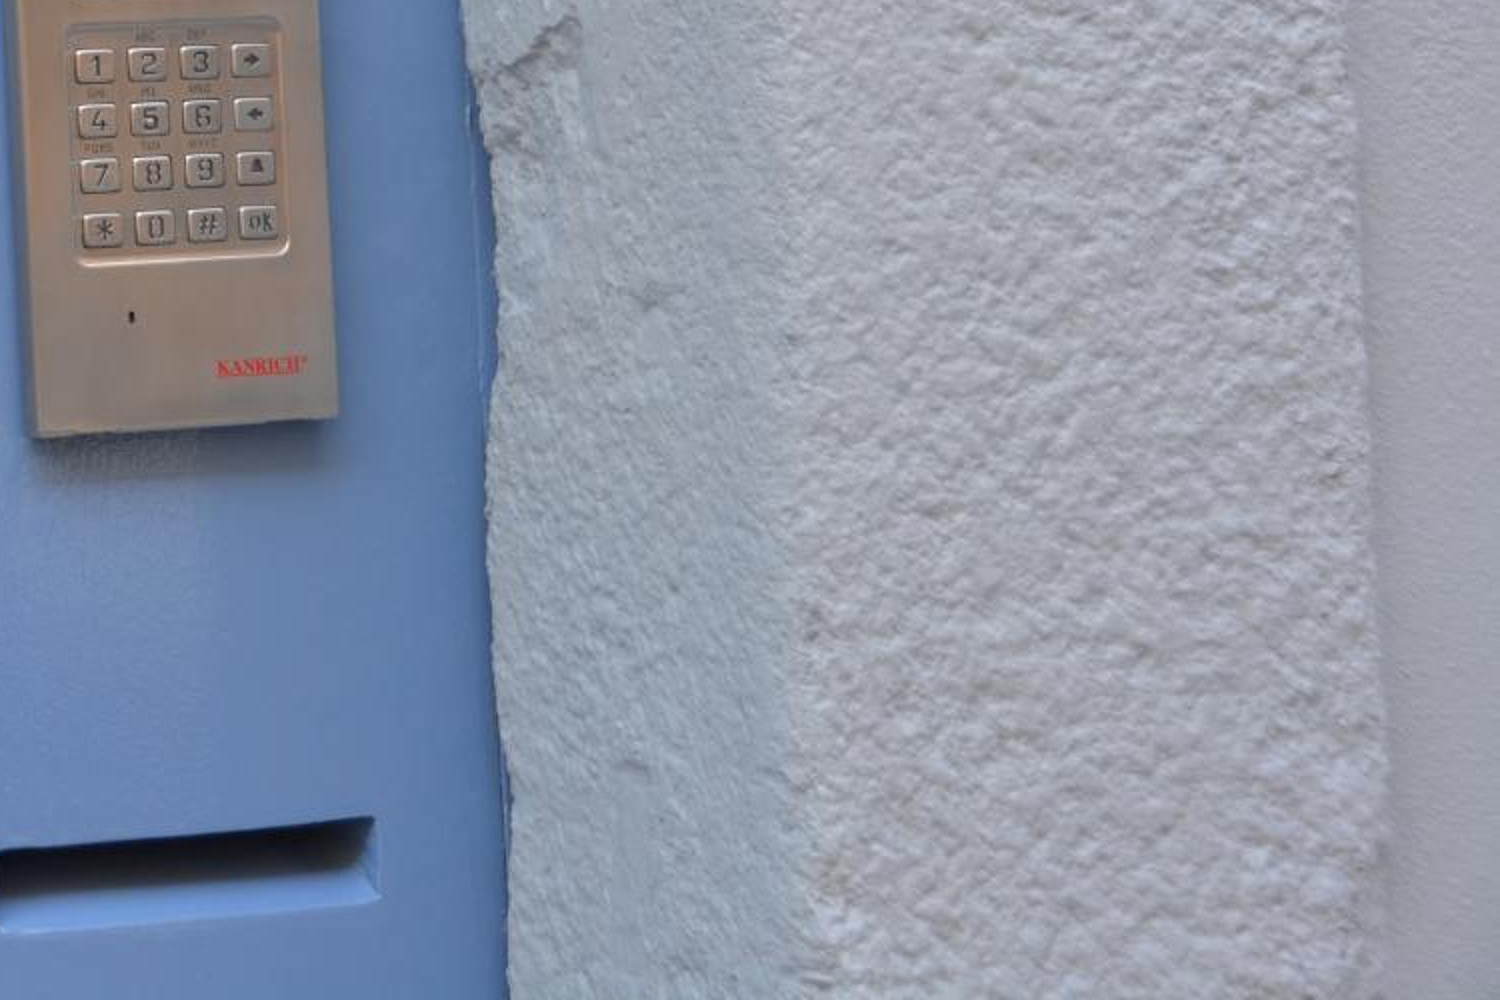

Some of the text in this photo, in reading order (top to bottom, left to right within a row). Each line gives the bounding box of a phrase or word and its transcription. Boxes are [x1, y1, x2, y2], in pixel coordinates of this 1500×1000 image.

[91, 50, 209, 76] 1 2 3
[92, 104, 212, 131] 4 5 6
[94, 158, 213, 186] 7 8 9
[149, 215, 165, 239] 0
